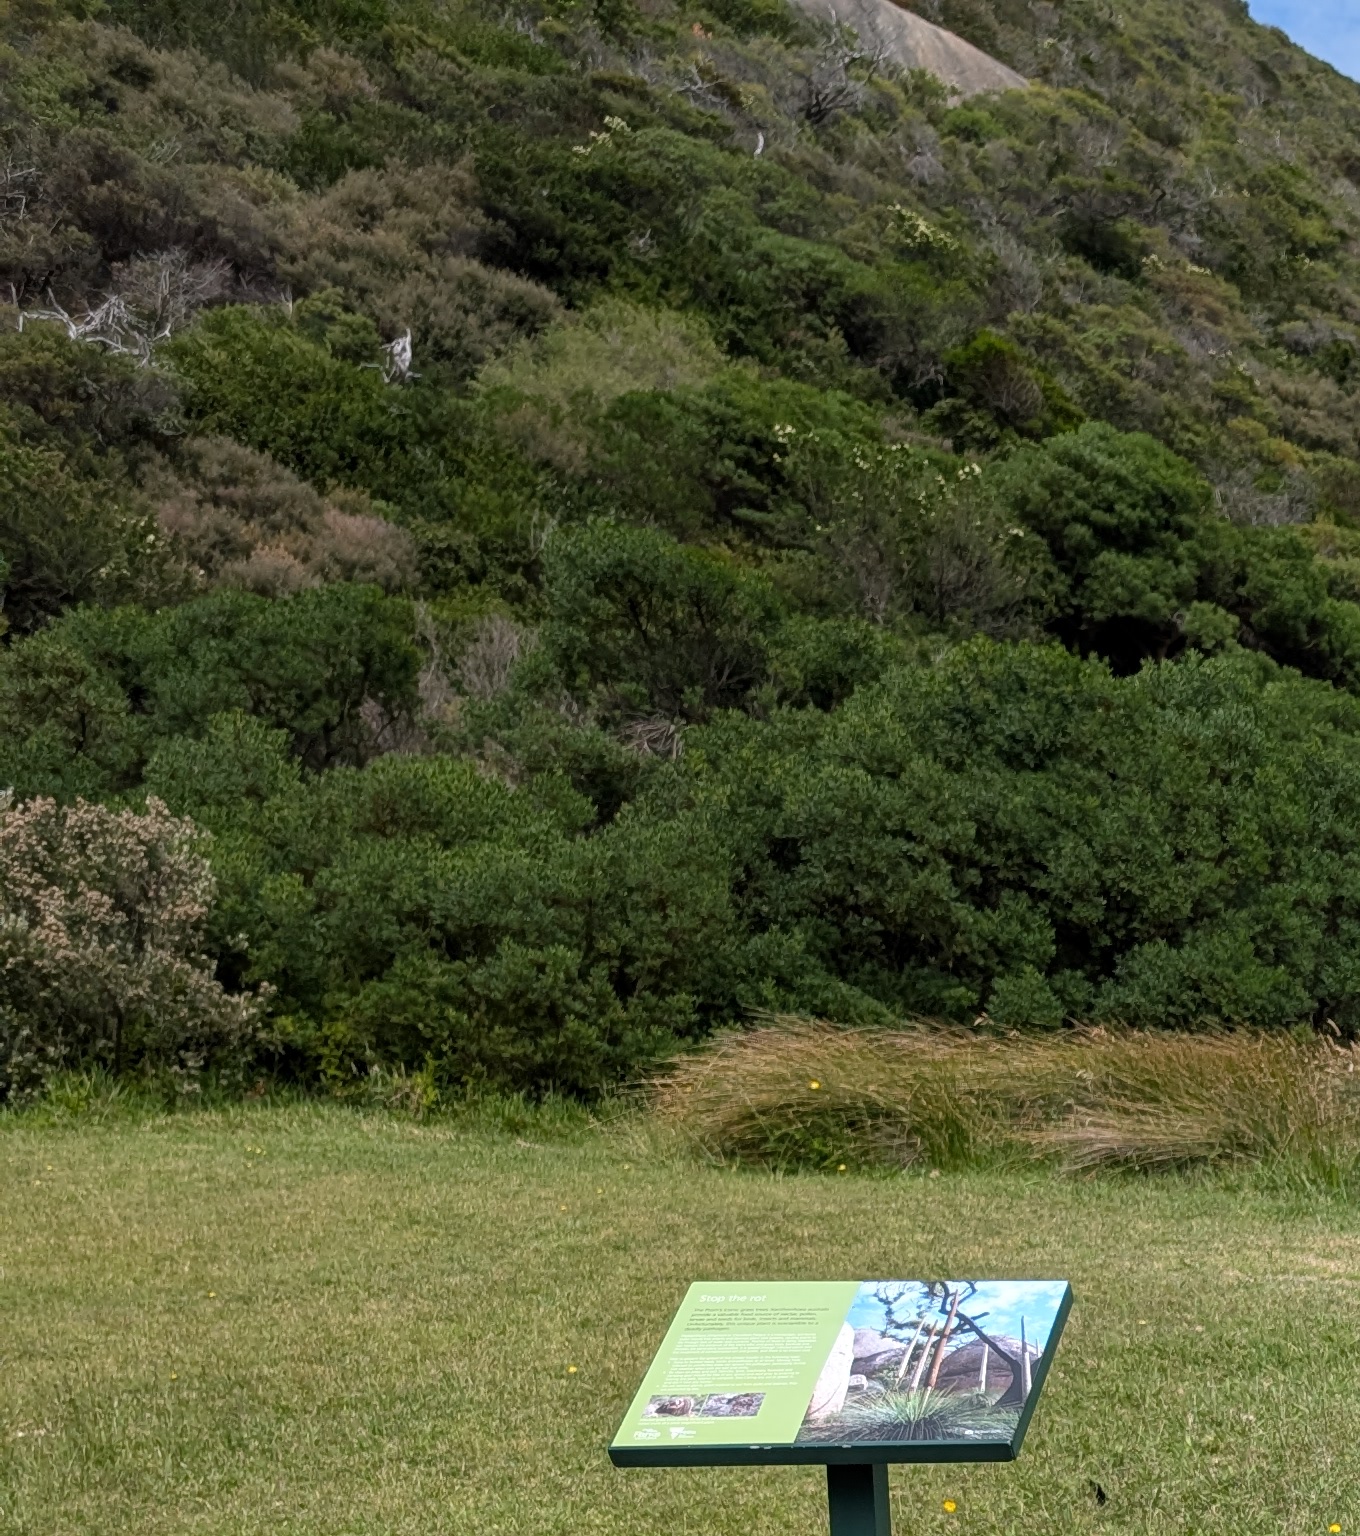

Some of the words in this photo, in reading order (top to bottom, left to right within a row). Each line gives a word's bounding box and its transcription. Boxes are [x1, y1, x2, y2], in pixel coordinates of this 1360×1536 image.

[699, 1294, 726, 1304] Stop
[729, 1294, 747, 1302] the
[749, 1294, 767, 1302] rot
